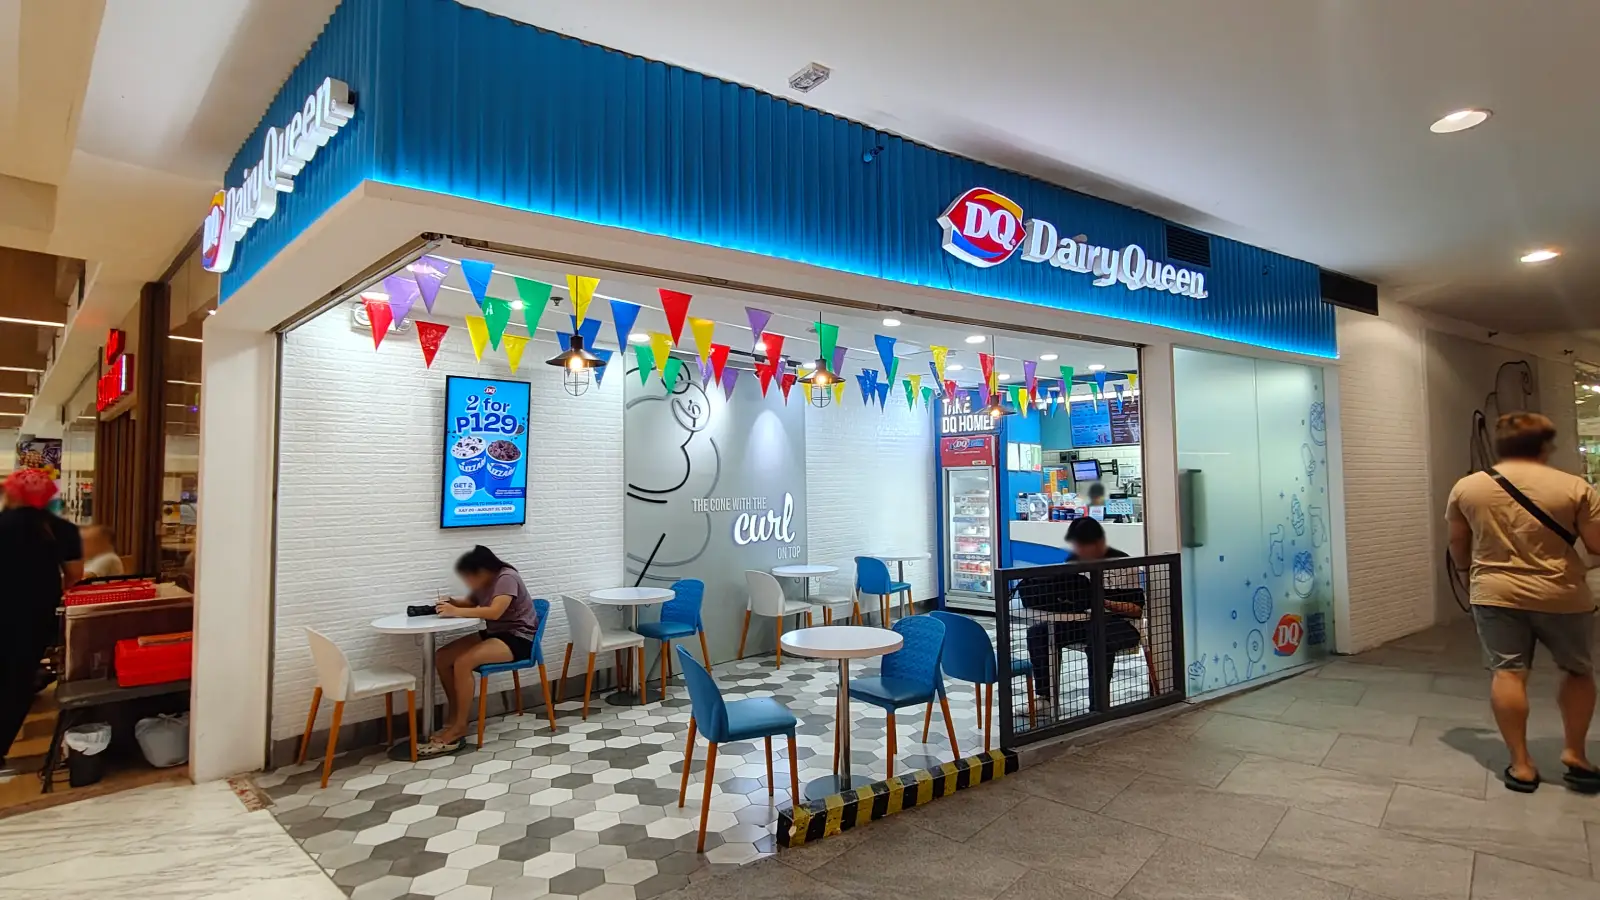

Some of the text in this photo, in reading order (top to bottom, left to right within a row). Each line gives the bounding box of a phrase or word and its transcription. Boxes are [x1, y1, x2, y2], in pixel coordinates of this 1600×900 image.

[963, 201, 1017, 249] DQ
[466, 394, 510, 413] 2 for
[456, 412, 518, 435] P129
[942, 416, 957, 433] DQ
[692, 496, 767, 512] THE CONE WITH THE
[734, 491, 796, 545] curl
[777, 545, 801, 560] ON TOP
[1278, 622, 1299, 647] DQ
